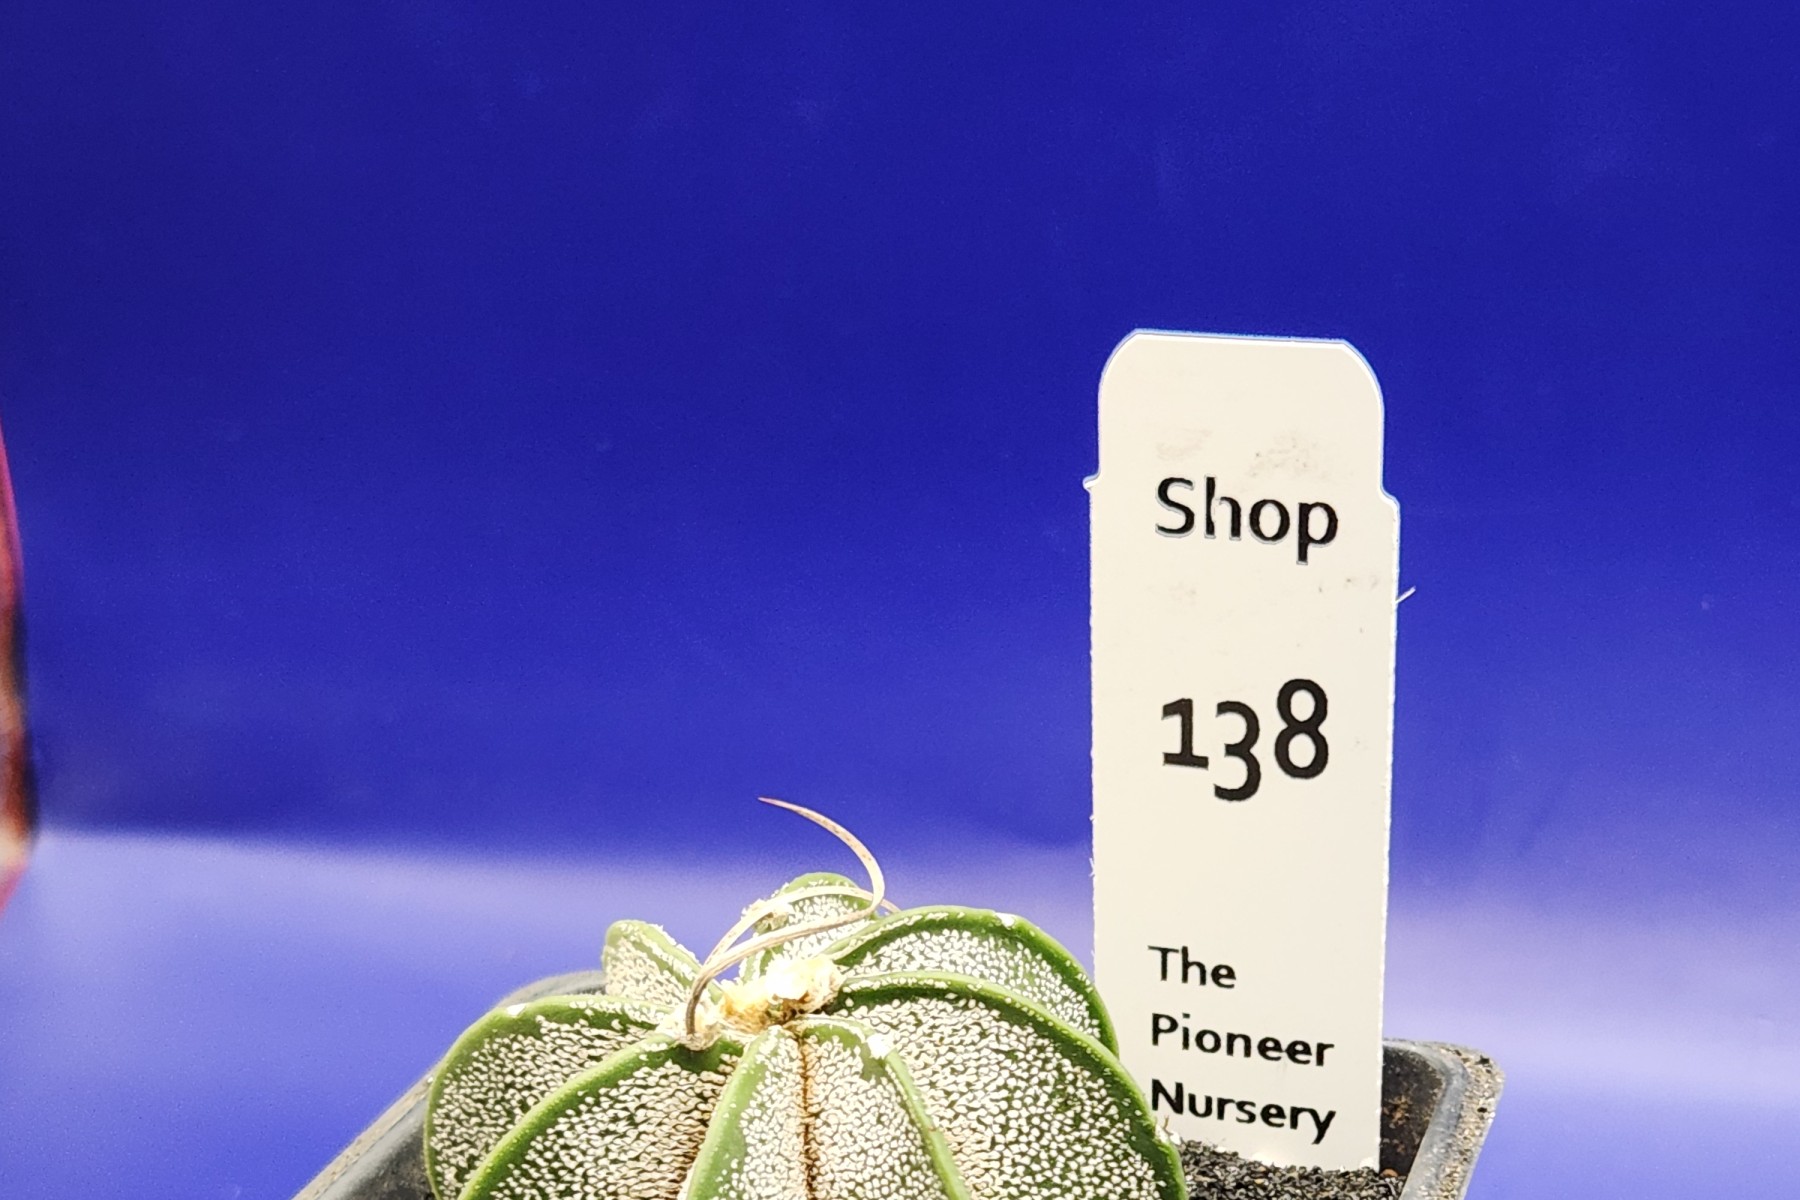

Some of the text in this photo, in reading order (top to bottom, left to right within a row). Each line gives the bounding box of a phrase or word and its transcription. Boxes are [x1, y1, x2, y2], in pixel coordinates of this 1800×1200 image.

[1155, 476, 1339, 565] Shop
[1161, 679, 1329, 802] 138
[1148, 945, 1237, 989] The
[1151, 1013, 1335, 1067] Pioneer
[1151, 1078, 1337, 1145] Nursery
